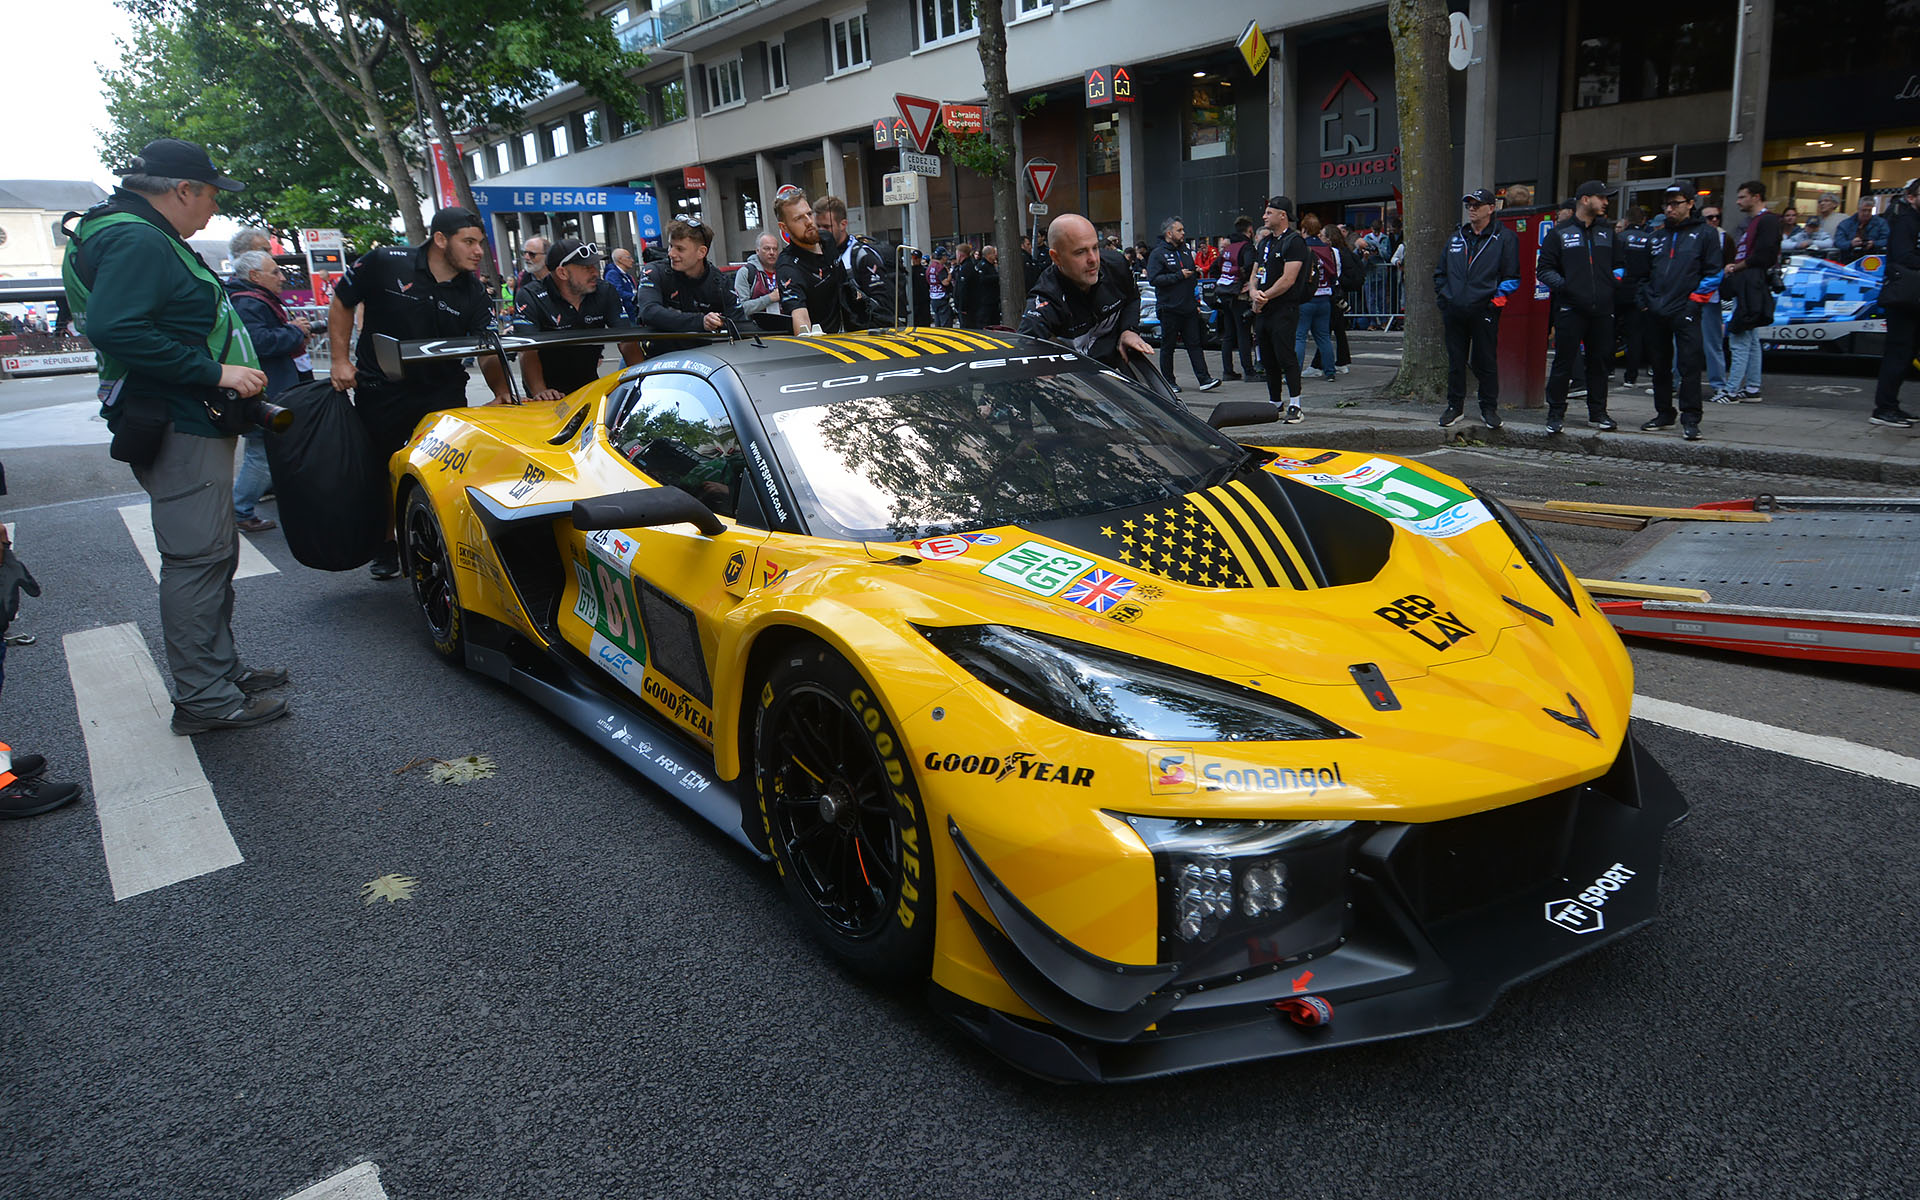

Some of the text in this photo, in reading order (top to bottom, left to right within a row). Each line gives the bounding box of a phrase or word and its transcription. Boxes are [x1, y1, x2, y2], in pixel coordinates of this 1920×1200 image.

[929, 158, 937, 166] LE
[513, 192, 608, 206] LE PESAGE
[779, 353, 1079, 394] CORVETTE
[508, 480, 535, 500] LAY
[521, 463, 546, 486] REP
[749, 440, 788, 524] www.TFSPORT.co.uk
[997, 547, 1049, 576] LM
[1025, 556, 1083, 590] GT3
[578, 591, 596, 621] GT3
[597, 563, 637, 650] 81
[1373, 594, 1439, 630] REP
[1408, 611, 1477, 652] LAY
[599, 645, 634, 676] WEC
[654, 754, 685, 776] HRX
[1203, 761, 1347, 797] Sonangol
[1553, 862, 1637, 926] TF SPORT
